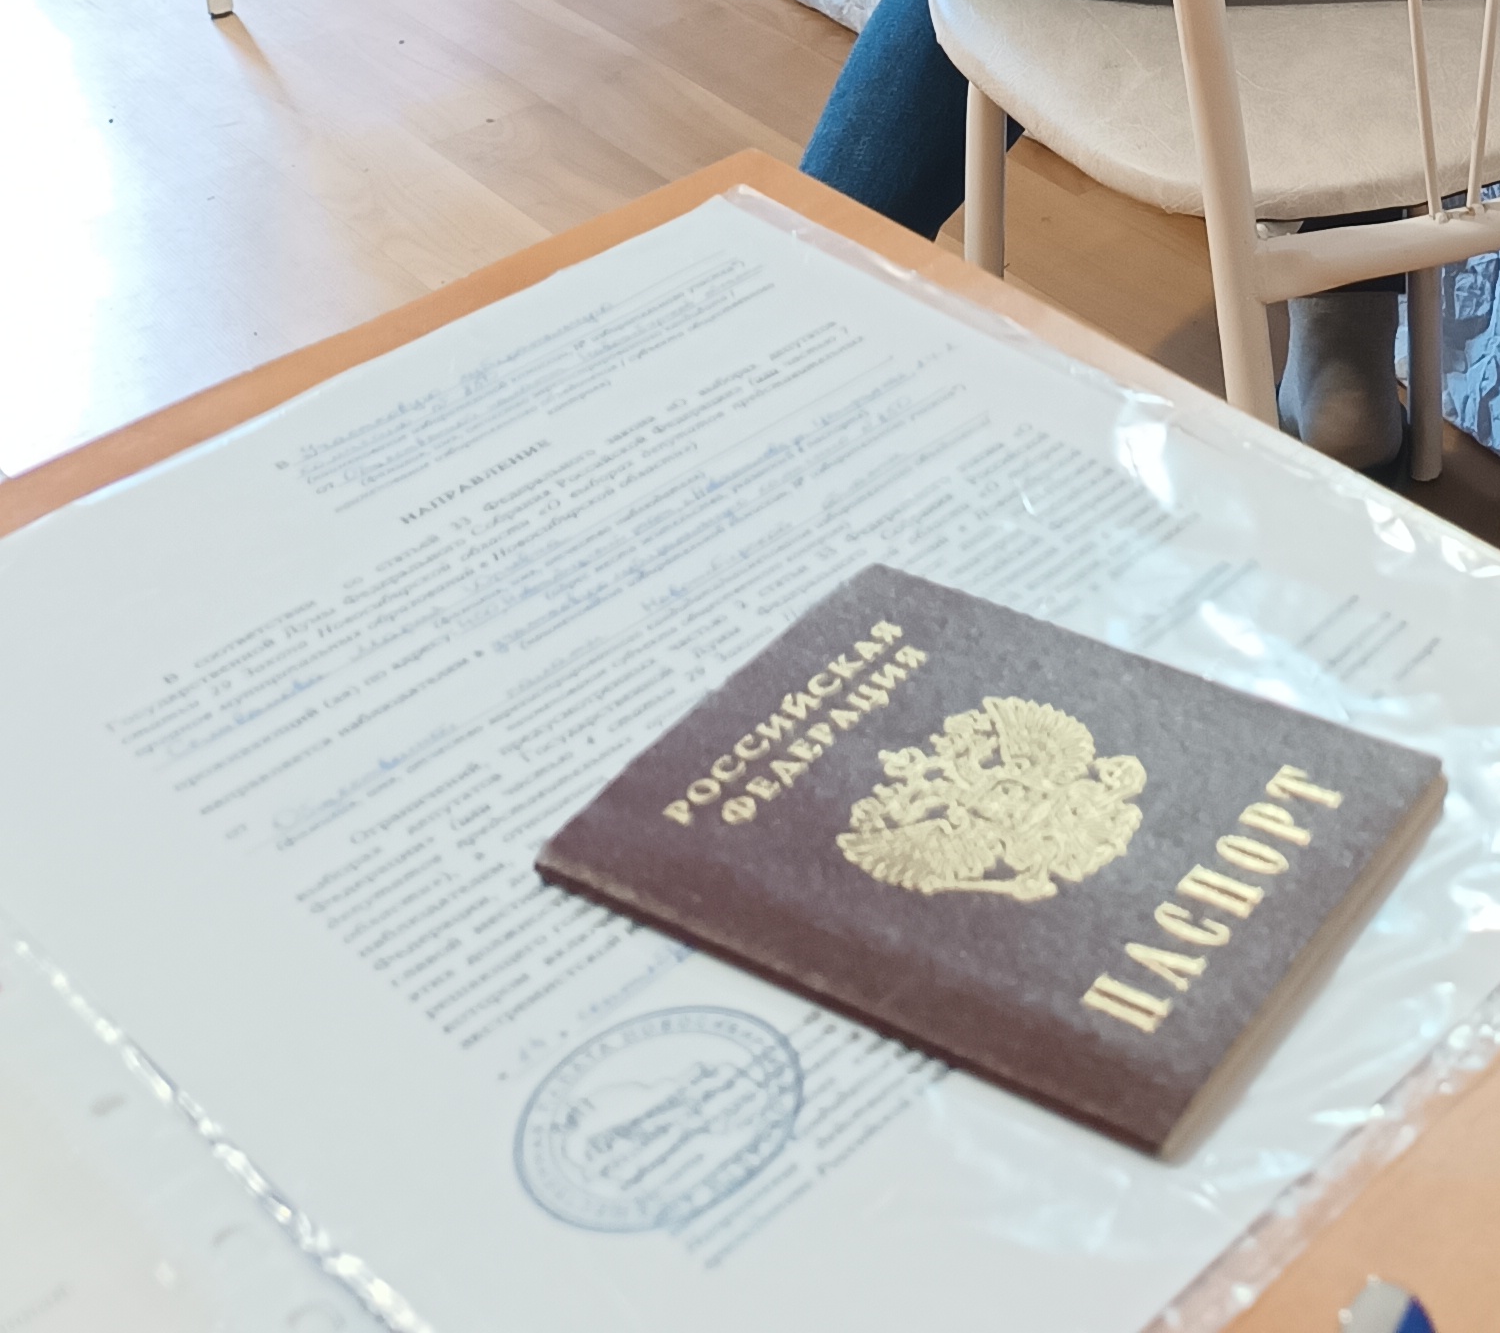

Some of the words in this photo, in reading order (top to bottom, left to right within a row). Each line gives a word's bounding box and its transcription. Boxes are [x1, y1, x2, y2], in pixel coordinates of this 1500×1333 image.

[395, 438, 555, 524] НАПРАВЛЕНИЕ
[662, 619, 905, 828] РОССИЙСКАЯ
[719, 645, 930, 829] ФЕДЕРАЦИЯ
[1080, 764, 1345, 1033] ПАСПОРТ
